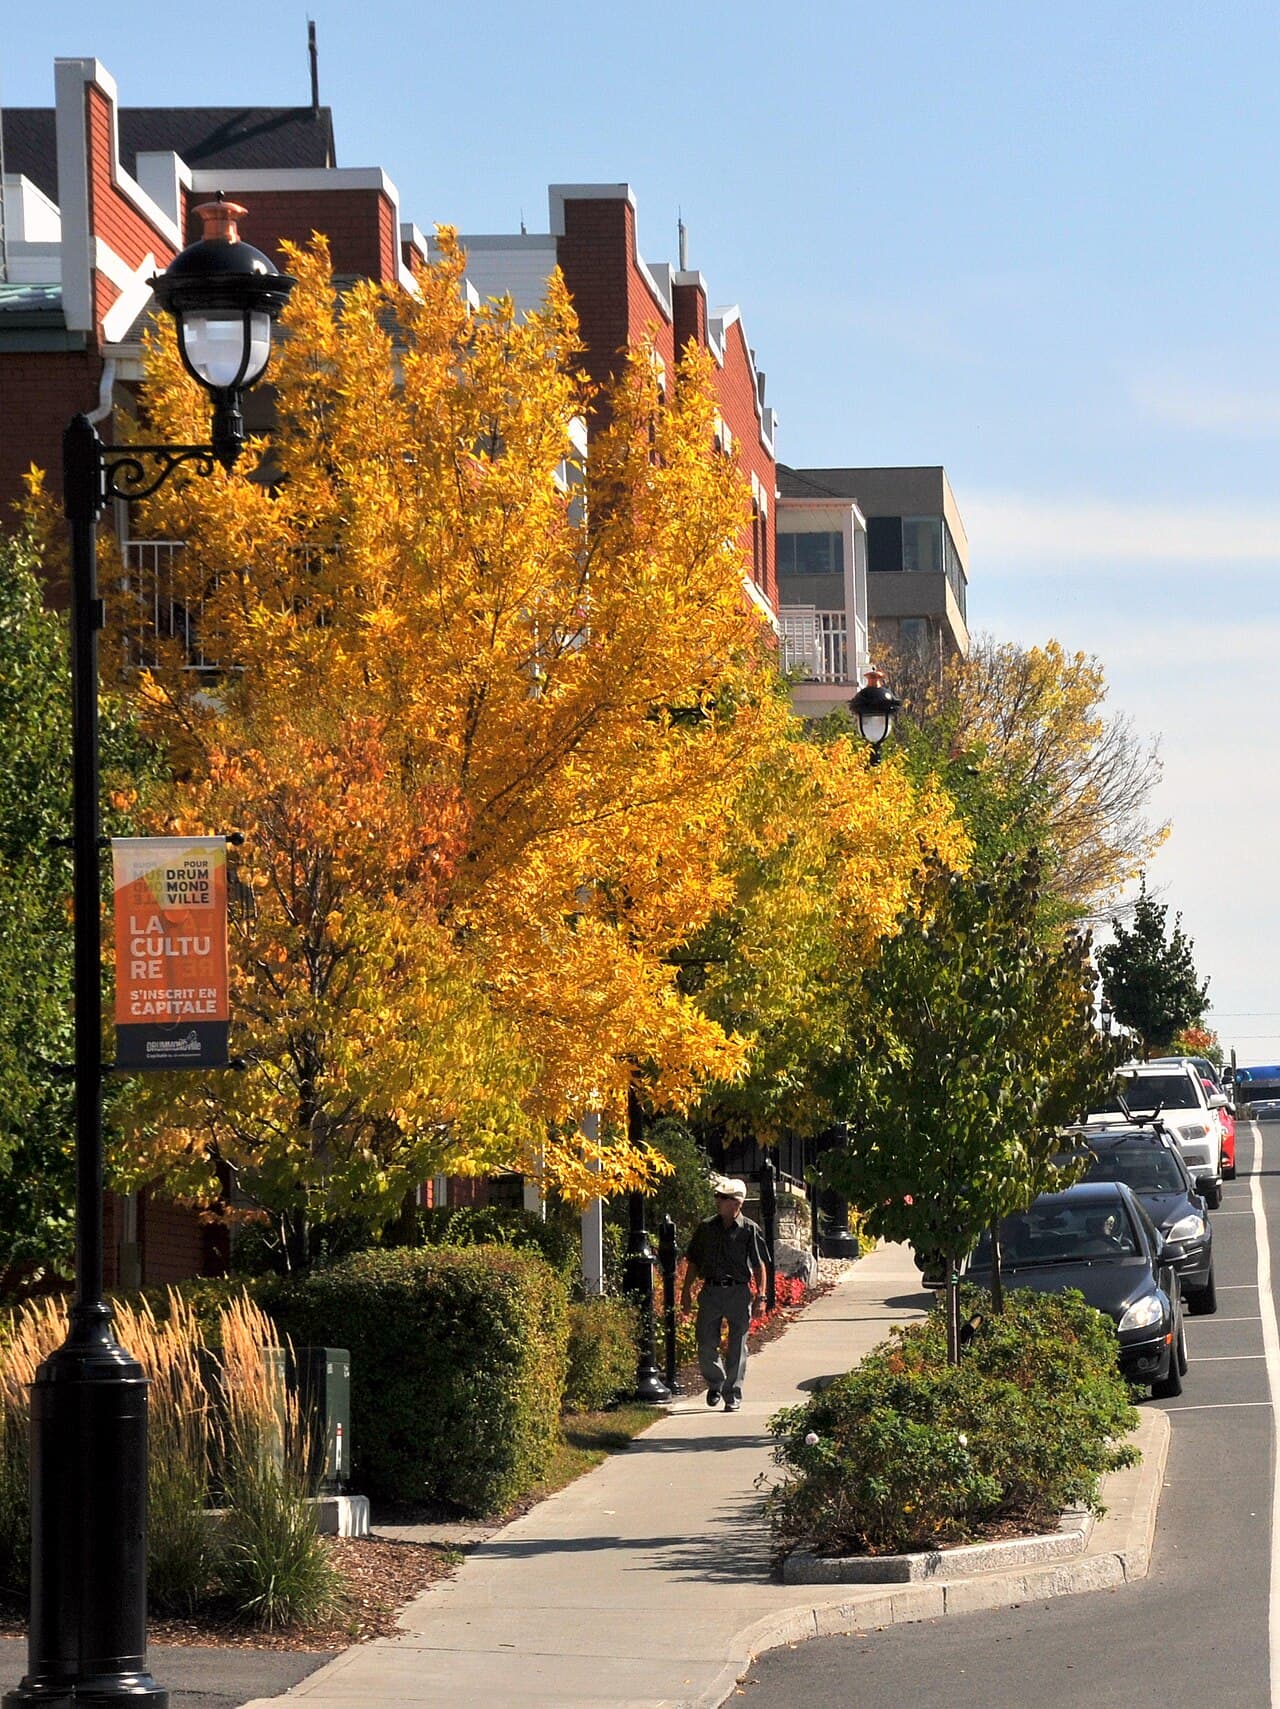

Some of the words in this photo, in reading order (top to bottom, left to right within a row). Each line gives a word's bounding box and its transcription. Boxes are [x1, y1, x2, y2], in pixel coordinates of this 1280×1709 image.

[166, 869, 209, 880] DRUM
[167, 881, 209, 892] MOND
[168, 893, 210, 904] VILLE
[129, 915, 164, 935] LA
[130, 936, 211, 957] CULTU
[131, 959, 164, 980] RE
[130, 988, 195, 1001] S'INSCRIT
[198, 988, 217, 999] EN
[130, 1000, 217, 1016] CAPITALE
